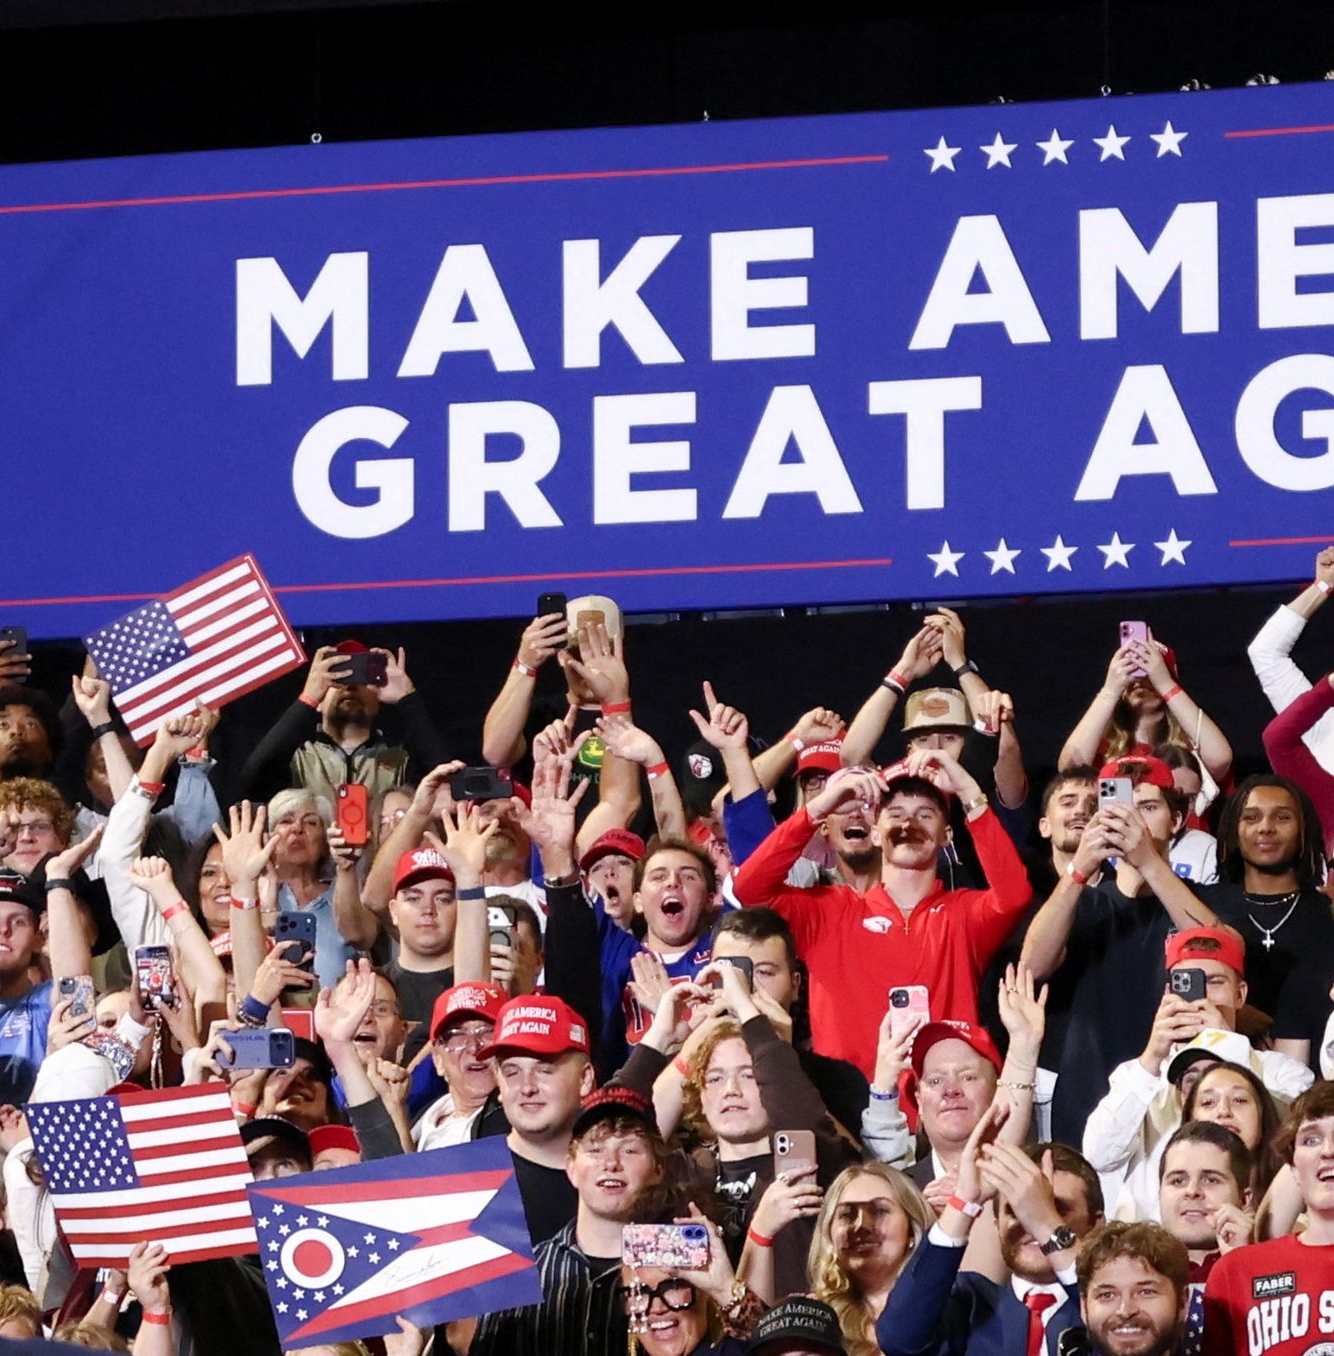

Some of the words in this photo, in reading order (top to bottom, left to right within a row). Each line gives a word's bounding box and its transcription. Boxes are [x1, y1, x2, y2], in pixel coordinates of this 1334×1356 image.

[237, 227, 815, 385] MAKE
[293, 376, 981, 538] GREAT
[515, 1006, 557, 1022] AMERICA
[520, 1022, 550, 1036] AGAIN
[1256, 1276, 1293, 1292] FABER
[757, 1306, 784, 1328] MAKE
[784, 1303, 832, 1323] AMERICA
[759, 1316, 792, 1338] GREAT
[792, 1316, 827, 1332] AGAIN
